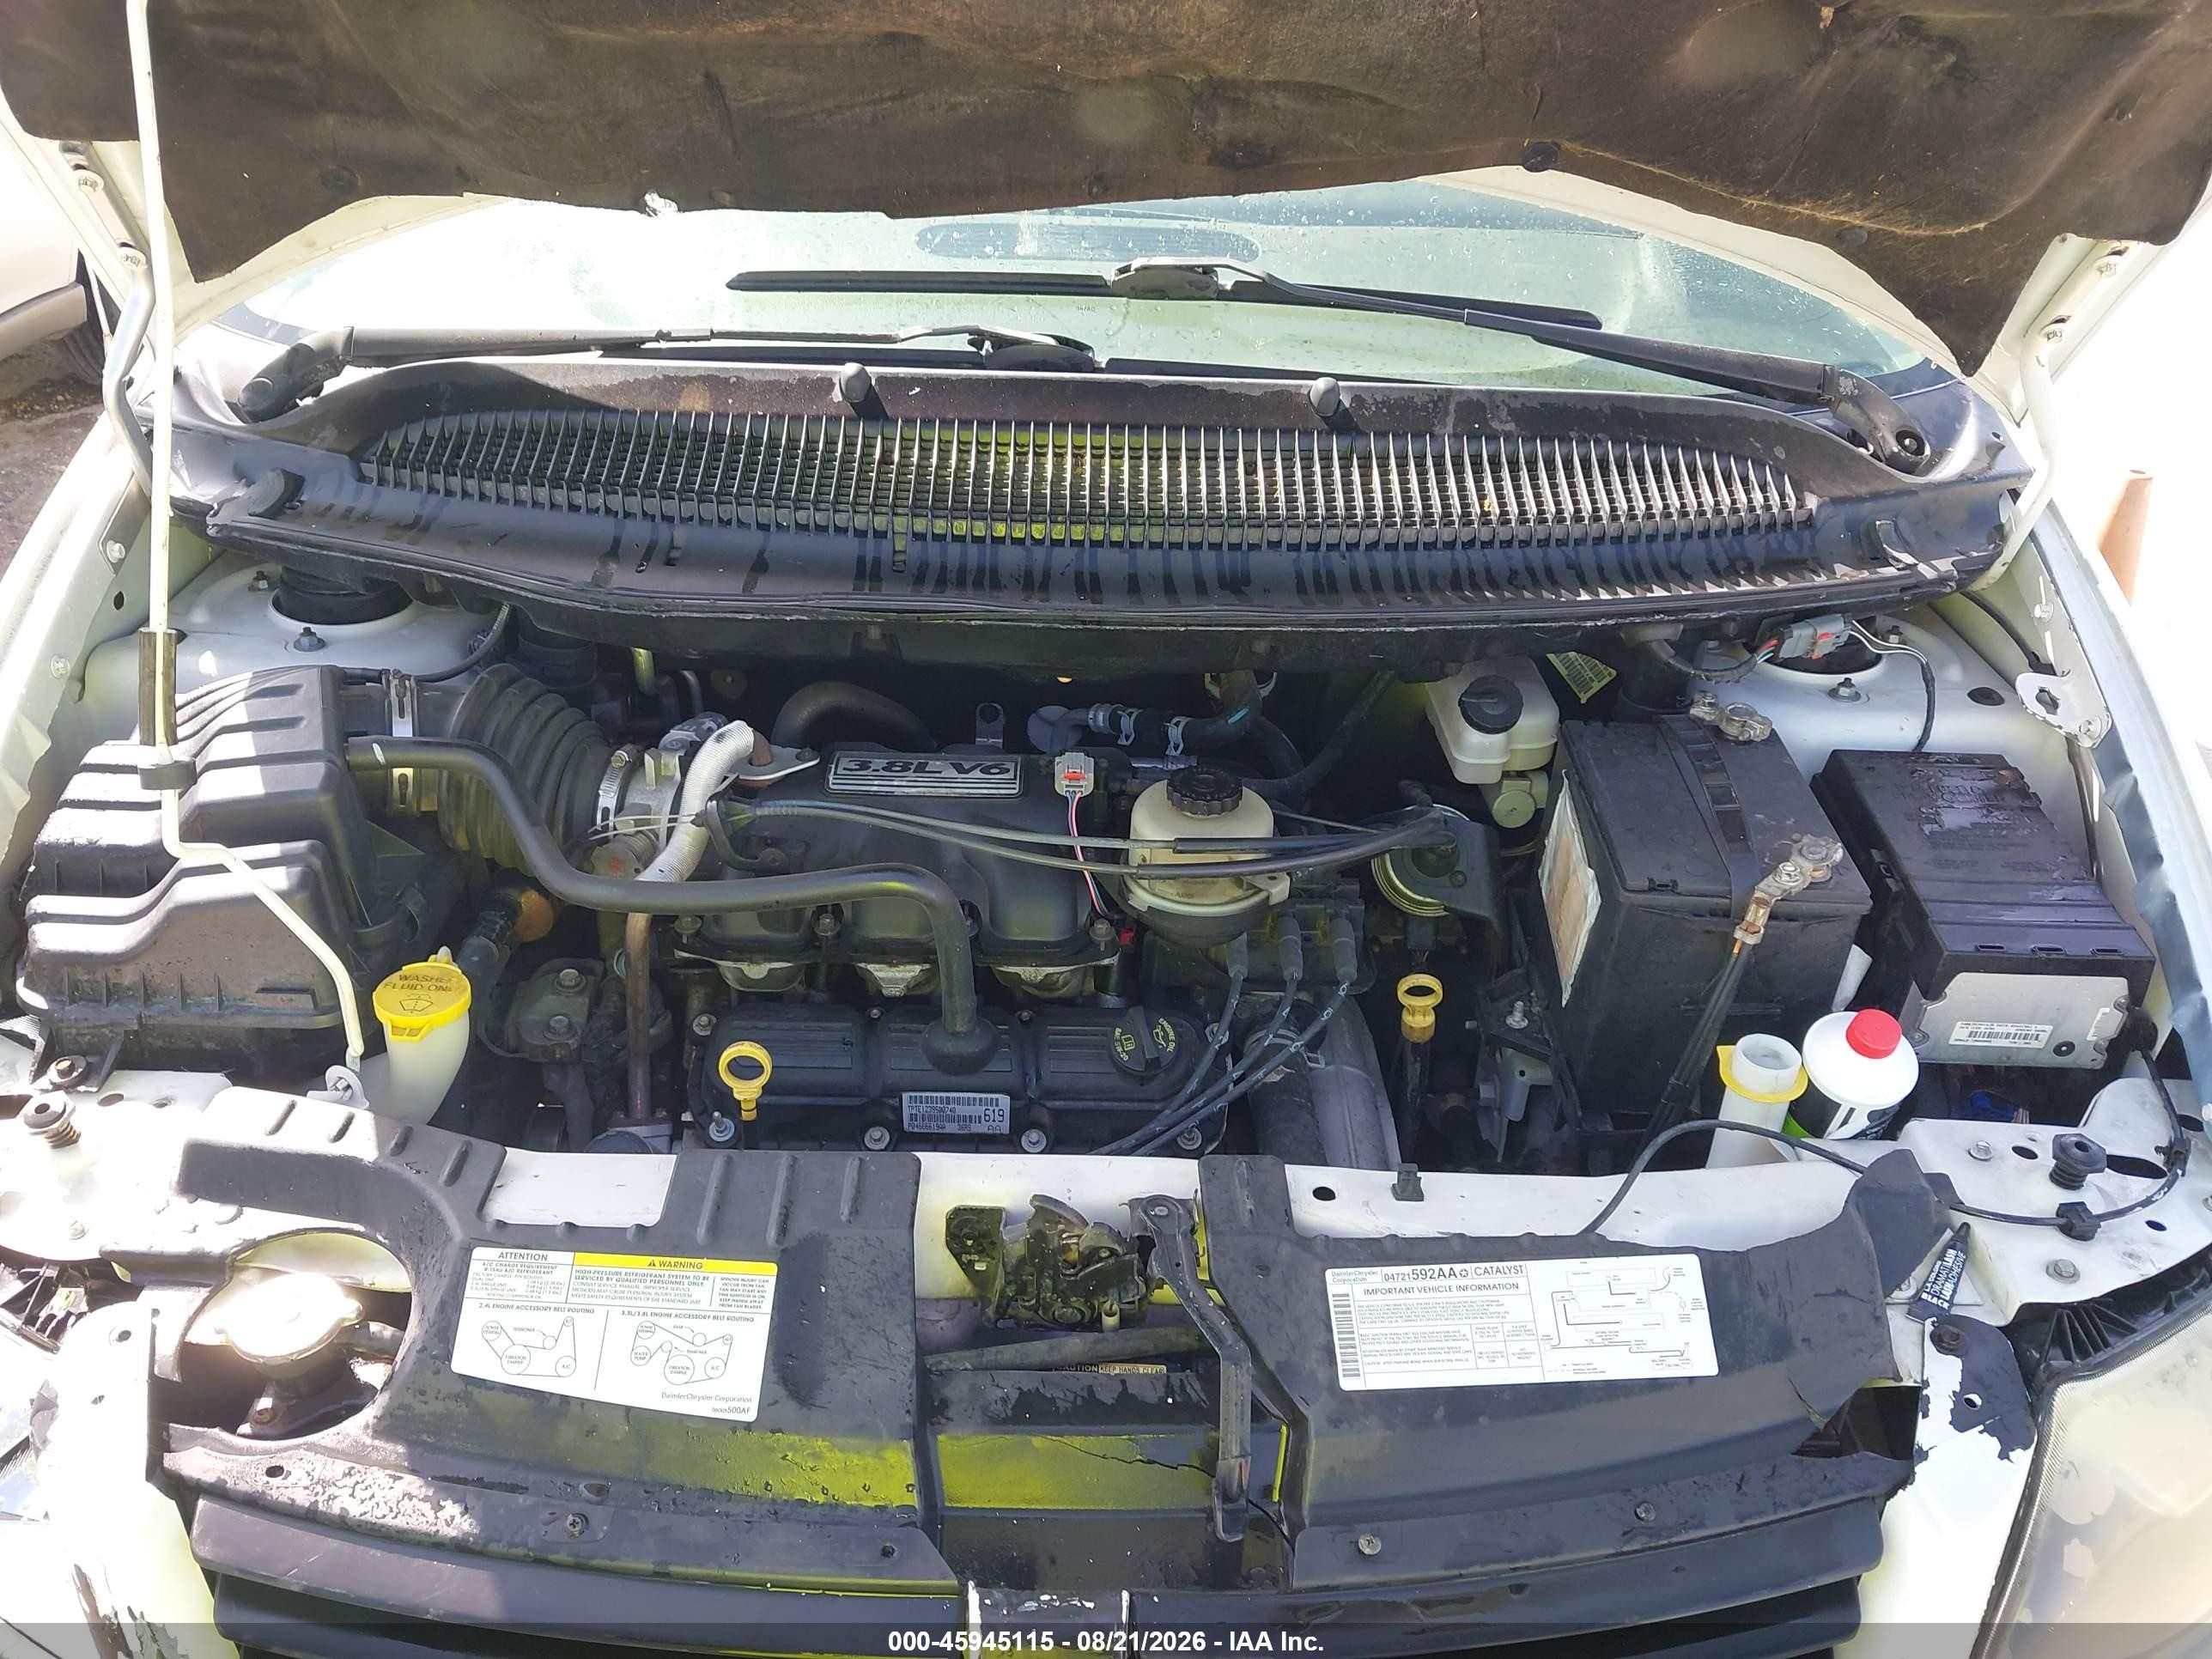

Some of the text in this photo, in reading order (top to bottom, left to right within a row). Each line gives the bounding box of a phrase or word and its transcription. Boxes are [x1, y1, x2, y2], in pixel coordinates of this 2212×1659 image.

[842, 759, 1011, 775] 3.8L V6
[383, 981, 454, 992] FLUID ON
[1166, 1042, 1176, 1052] OIL
[983, 1108, 1005, 1123] 619
[498, 1251, 549, 1261] ATTENTION
[658, 1260, 704, 1270] WARNING
[1474, 1264, 1524, 1277] CATALYST
[574, 1268, 623, 1277] HIGH-PRESSURE
[1364, 1282, 1520, 1296] IMPORTANT VEHICLE INFORMATION
[1921, 1291, 1950, 1310] BLACK
[674, 1312, 710, 1321] ACCESSORY
[1100, 1364, 1118, 1374] KEEP
[1120, 1365, 1140, 1374] HANDS
[661, 1391, 752, 1404] DaimlerChrysler Corporation
